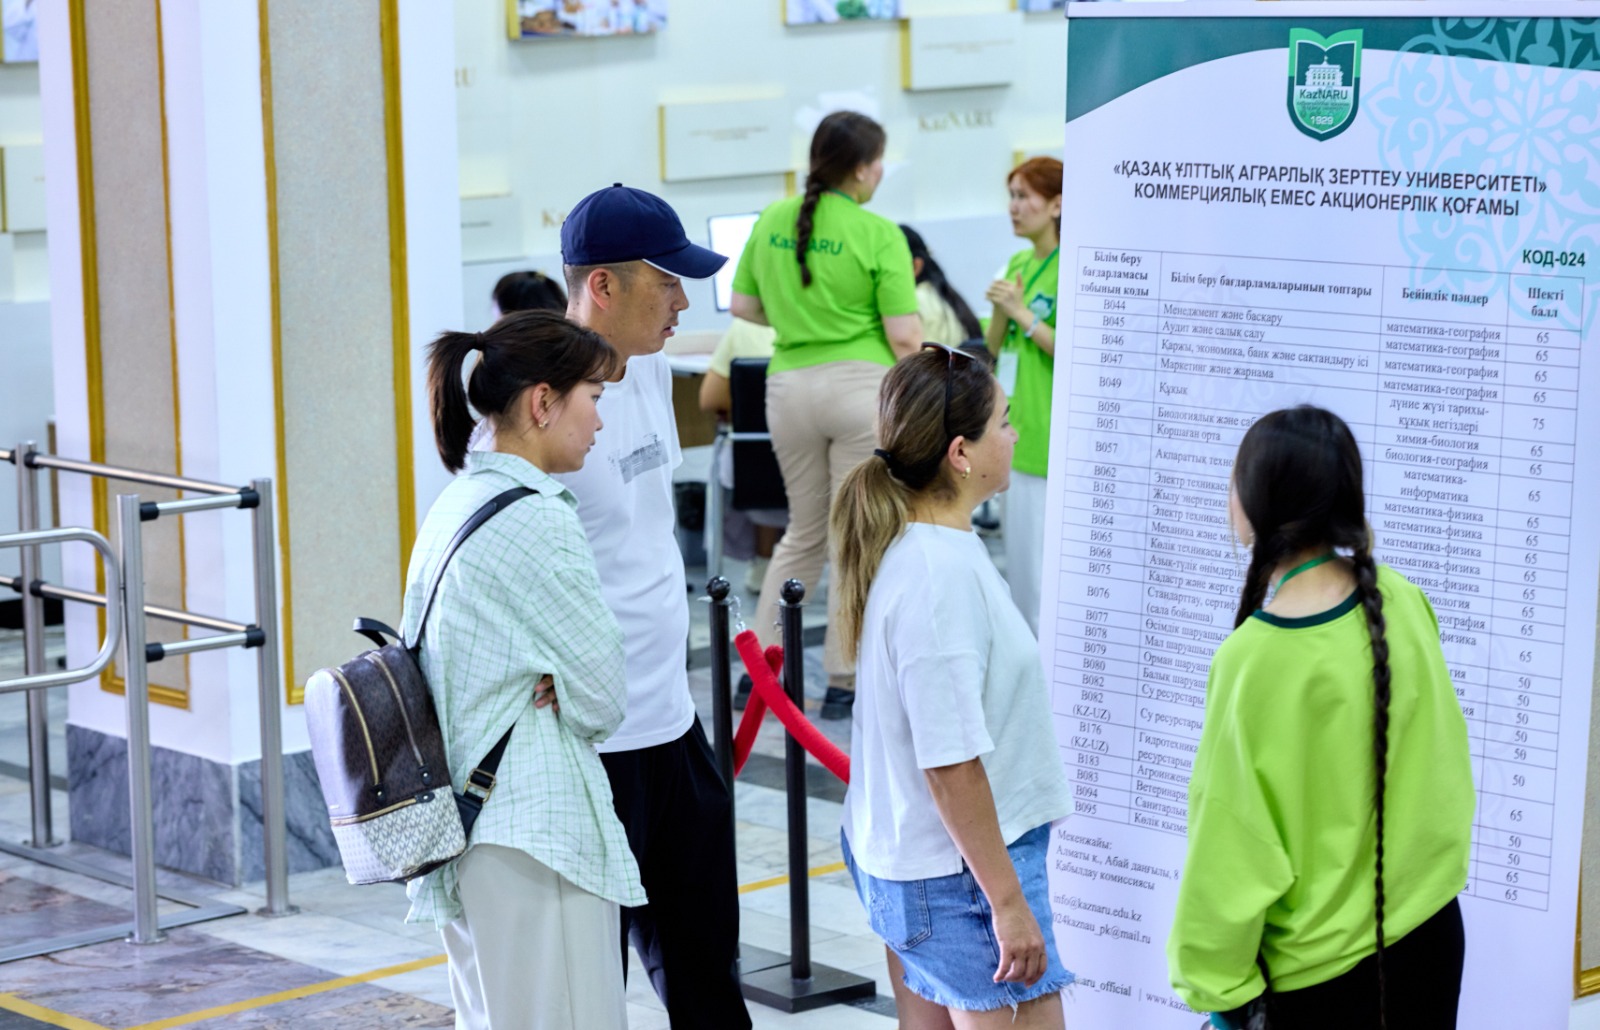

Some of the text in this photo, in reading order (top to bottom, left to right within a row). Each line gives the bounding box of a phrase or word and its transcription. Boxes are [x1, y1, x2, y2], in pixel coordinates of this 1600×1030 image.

[1300, 89, 1348, 100] KazNARU
[1310, 116, 1334, 125] 1929
[1238, 165, 1324, 186] АГРАРЛЫҚ
[1329, 168, 1401, 186] ЗЕРТТЕУ
[1134, 182, 1519, 216] КОММЕРЦИЯЛЫҚ ЕМЕС АКЦИОНЕРЛІК ҚОҒАМЫ
[769, 232, 843, 256] KazARU
[1094, 251, 1142, 266] Білім беру
[1522, 249, 1586, 268] КОД-024
[1124, 286, 1149, 296] коды
[1171, 272, 1372, 298] Білім беру топтары
[1402, 287, 1488, 306] Бейіндік пәндер
[1528, 287, 1564, 300] Шекті
[1164, 304, 1219, 318] Менеджмент
[1531, 305, 1558, 318] балл
[1162, 320, 1190, 334] Аудит
[1244, 330, 1265, 342] салу
[1386, 322, 1500, 341] математика-география
[1536, 332, 1550, 344] 65
[1196, 344, 1245, 358] экономика,
[1248, 346, 1270, 359] банк
[1386, 338, 1500, 359] математика-география
[1536, 350, 1548, 362] 65
[1161, 358, 1207, 373] Маркетинг
[1233, 367, 1274, 380] жарнама
[1384, 359, 1499, 380] математика-география
[1535, 371, 1547, 382] 65
[1384, 380, 1498, 400] математика-география
[1534, 392, 1546, 403] 65
[1448, 404, 1489, 416] тарихы-
[1432, 418, 1478, 435] негіздері
[1532, 417, 1545, 430] 75
[1201, 432, 1220, 443] орта
[1396, 433, 1480, 450] химия-биология
[1530, 445, 1543, 457] 65
[1209, 456, 1234, 467] техно
[1385, 448, 1489, 472] биология-география
[1530, 464, 1542, 476] 65
[1155, 472, 1185, 489] Электр
[1404, 471, 1467, 485] математика-
[1153, 488, 1179, 505] Жылу
[1400, 486, 1468, 503] информатика
[1528, 490, 1541, 502] 65
[1153, 505, 1183, 522] Электр
[1384, 502, 1484, 523] математика-физика
[1152, 521, 1194, 537] Механика
[1383, 519, 1483, 540] математика-физика
[1527, 517, 1540, 529] 65
[1150, 537, 1221, 558] Көлік техникасы
[1382, 536, 1482, 557] математика-физика
[1526, 535, 1538, 547] 65
[1382, 553, 1480, 575] математика-физика
[1525, 553, 1538, 564] 65
[1148, 570, 1184, 588] Кадастр
[1208, 582, 1235, 595] жерге
[1524, 570, 1536, 583] 65
[1147, 586, 1237, 613] Стандарттау, сертиф
[1523, 588, 1536, 601] 65
[1147, 602, 1213, 624] (сала бойынша)
[1522, 606, 1534, 618] 65
[1146, 618, 1179, 634] Өсімдік
[1521, 624, 1533, 637] 65
[1145, 635, 1164, 648] Мал
[1144, 651, 1173, 665] Орман
[1519, 651, 1532, 663] 65
[1142, 683, 1155, 698] Су
[1518, 678, 1531, 690] 50
[1517, 695, 1530, 708] 50
[1073, 704, 1111, 722] (KZ-UZ)
[1140, 707, 1153, 722] Су
[1516, 713, 1529, 725] 50
[1514, 731, 1527, 743] 50
[1071, 735, 1109, 754] (KZ-UZ)
[1514, 749, 1527, 761] 50
[1137, 764, 1190, 784] Агроинжене
[1512, 775, 1525, 787] 50
[1134, 812, 1159, 826] Көлік
[1510, 810, 1523, 822] 65
[1509, 836, 1521, 848] 50
[1056, 845, 1089, 861] Алматы
[1105, 855, 1129, 869] Абай
[1508, 854, 1520, 866] 50
[1100, 872, 1155, 890] комиссиясы
[1506, 871, 1519, 884] 65
[1505, 889, 1518, 902] 65
[1053, 892, 1142, 922] info@kaznaru.edu.kz
